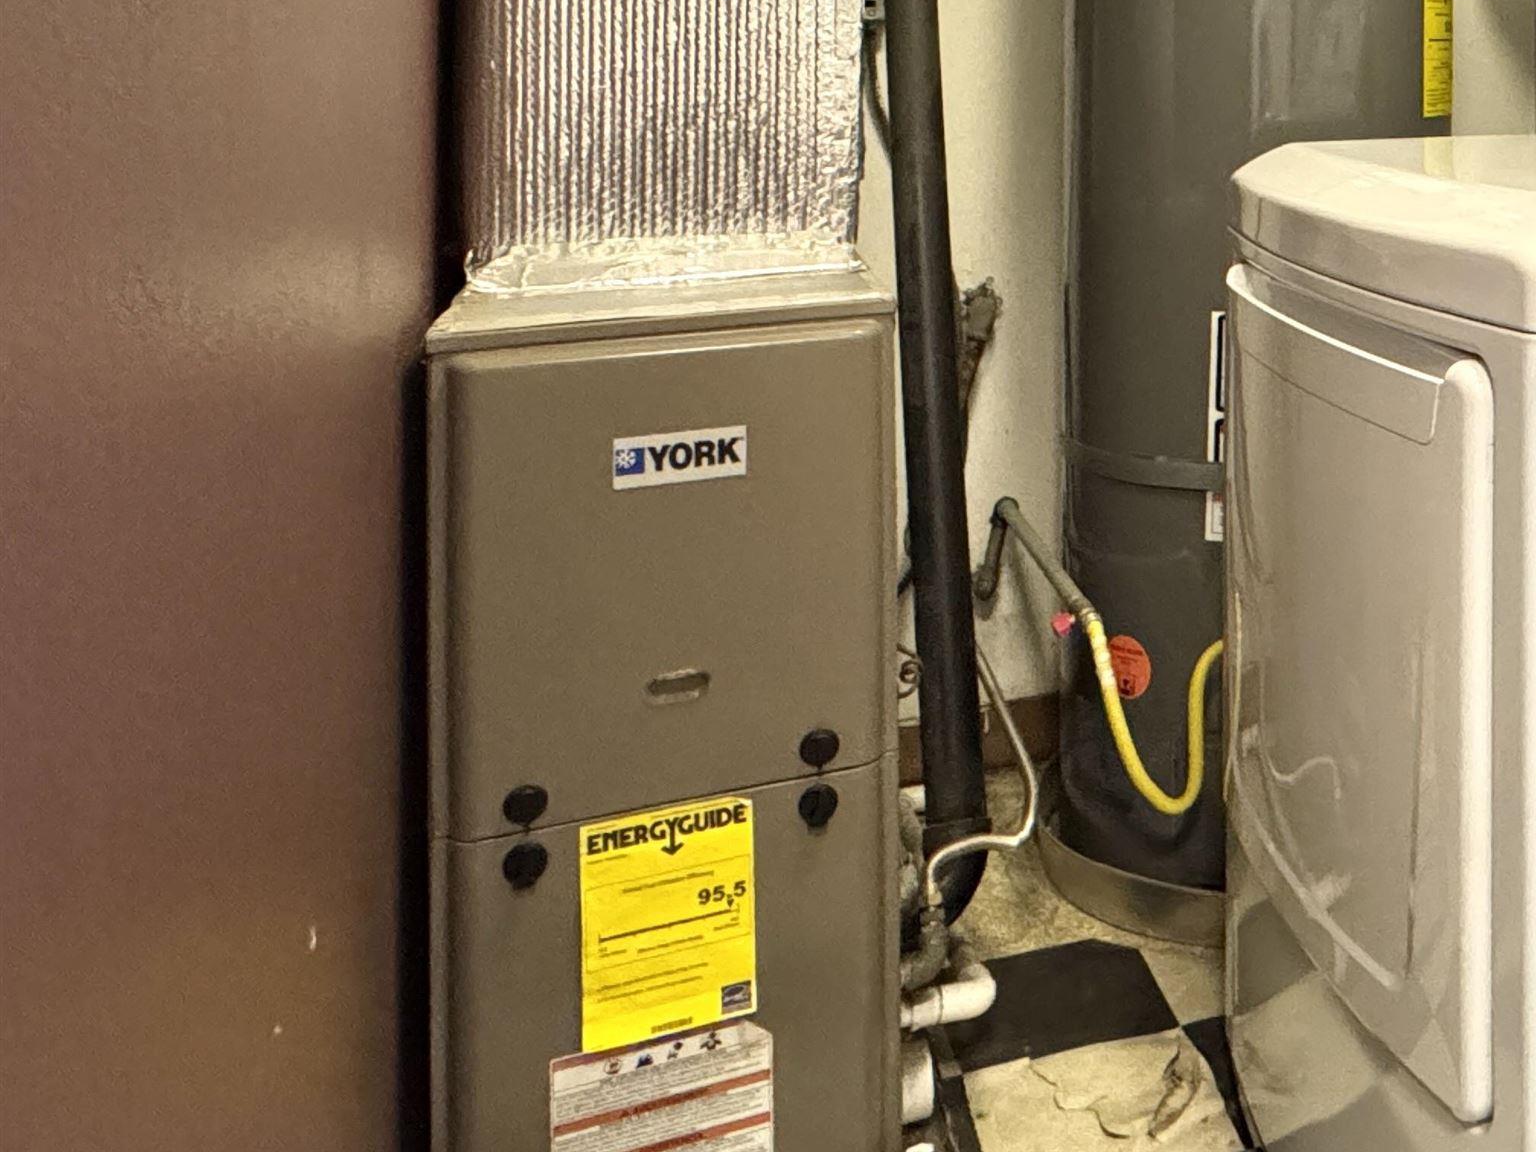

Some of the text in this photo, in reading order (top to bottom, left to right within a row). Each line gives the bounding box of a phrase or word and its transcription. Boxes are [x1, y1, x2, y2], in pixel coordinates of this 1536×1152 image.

[648, 437, 742, 471] YORK
[586, 804, 748, 856] ENERGYGUIDE
[698, 880, 748, 905] 95.5
